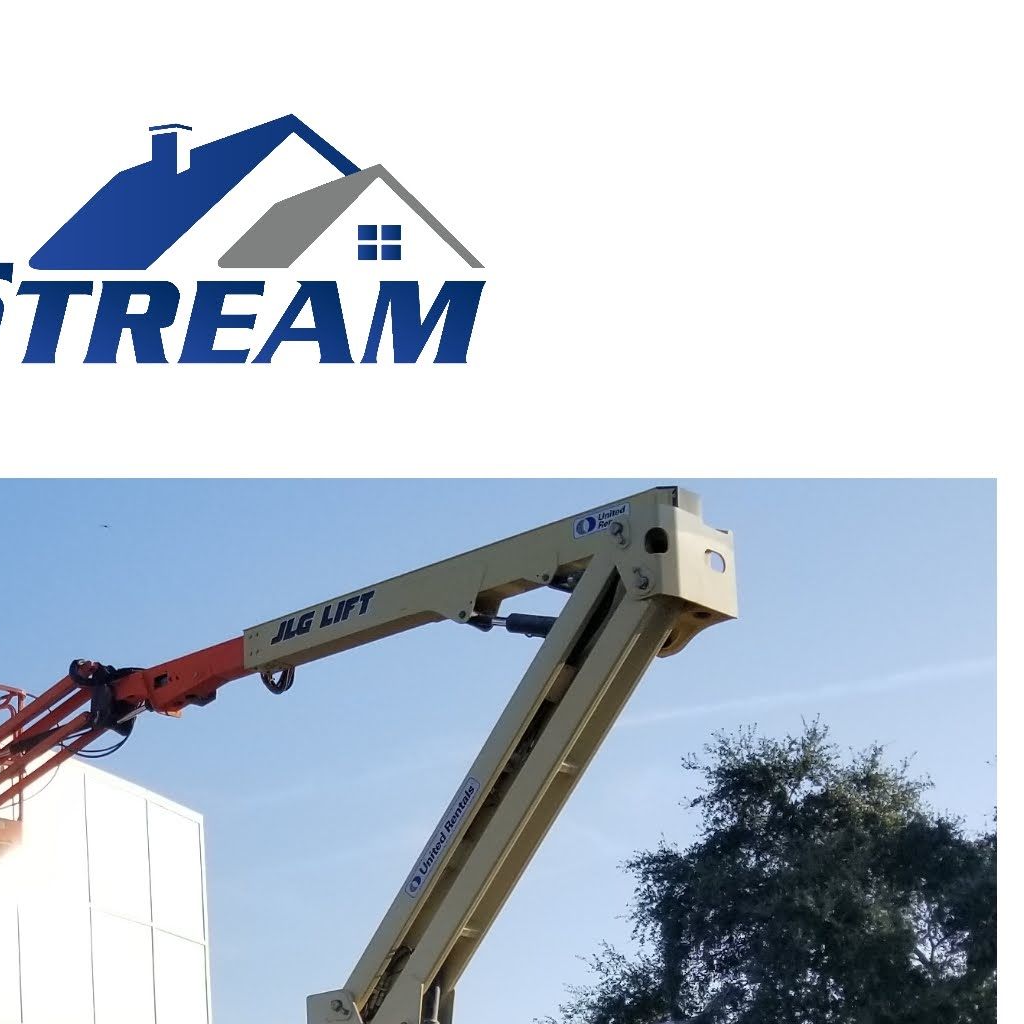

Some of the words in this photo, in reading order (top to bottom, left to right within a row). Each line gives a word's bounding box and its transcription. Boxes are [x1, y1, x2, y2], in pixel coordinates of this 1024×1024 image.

[597, 504, 626, 521] United
[270, 610, 316, 646] JLG
[319, 590, 376, 629] LIFT
[419, 831, 447, 876] United
[443, 784, 476, 834] Rentals
